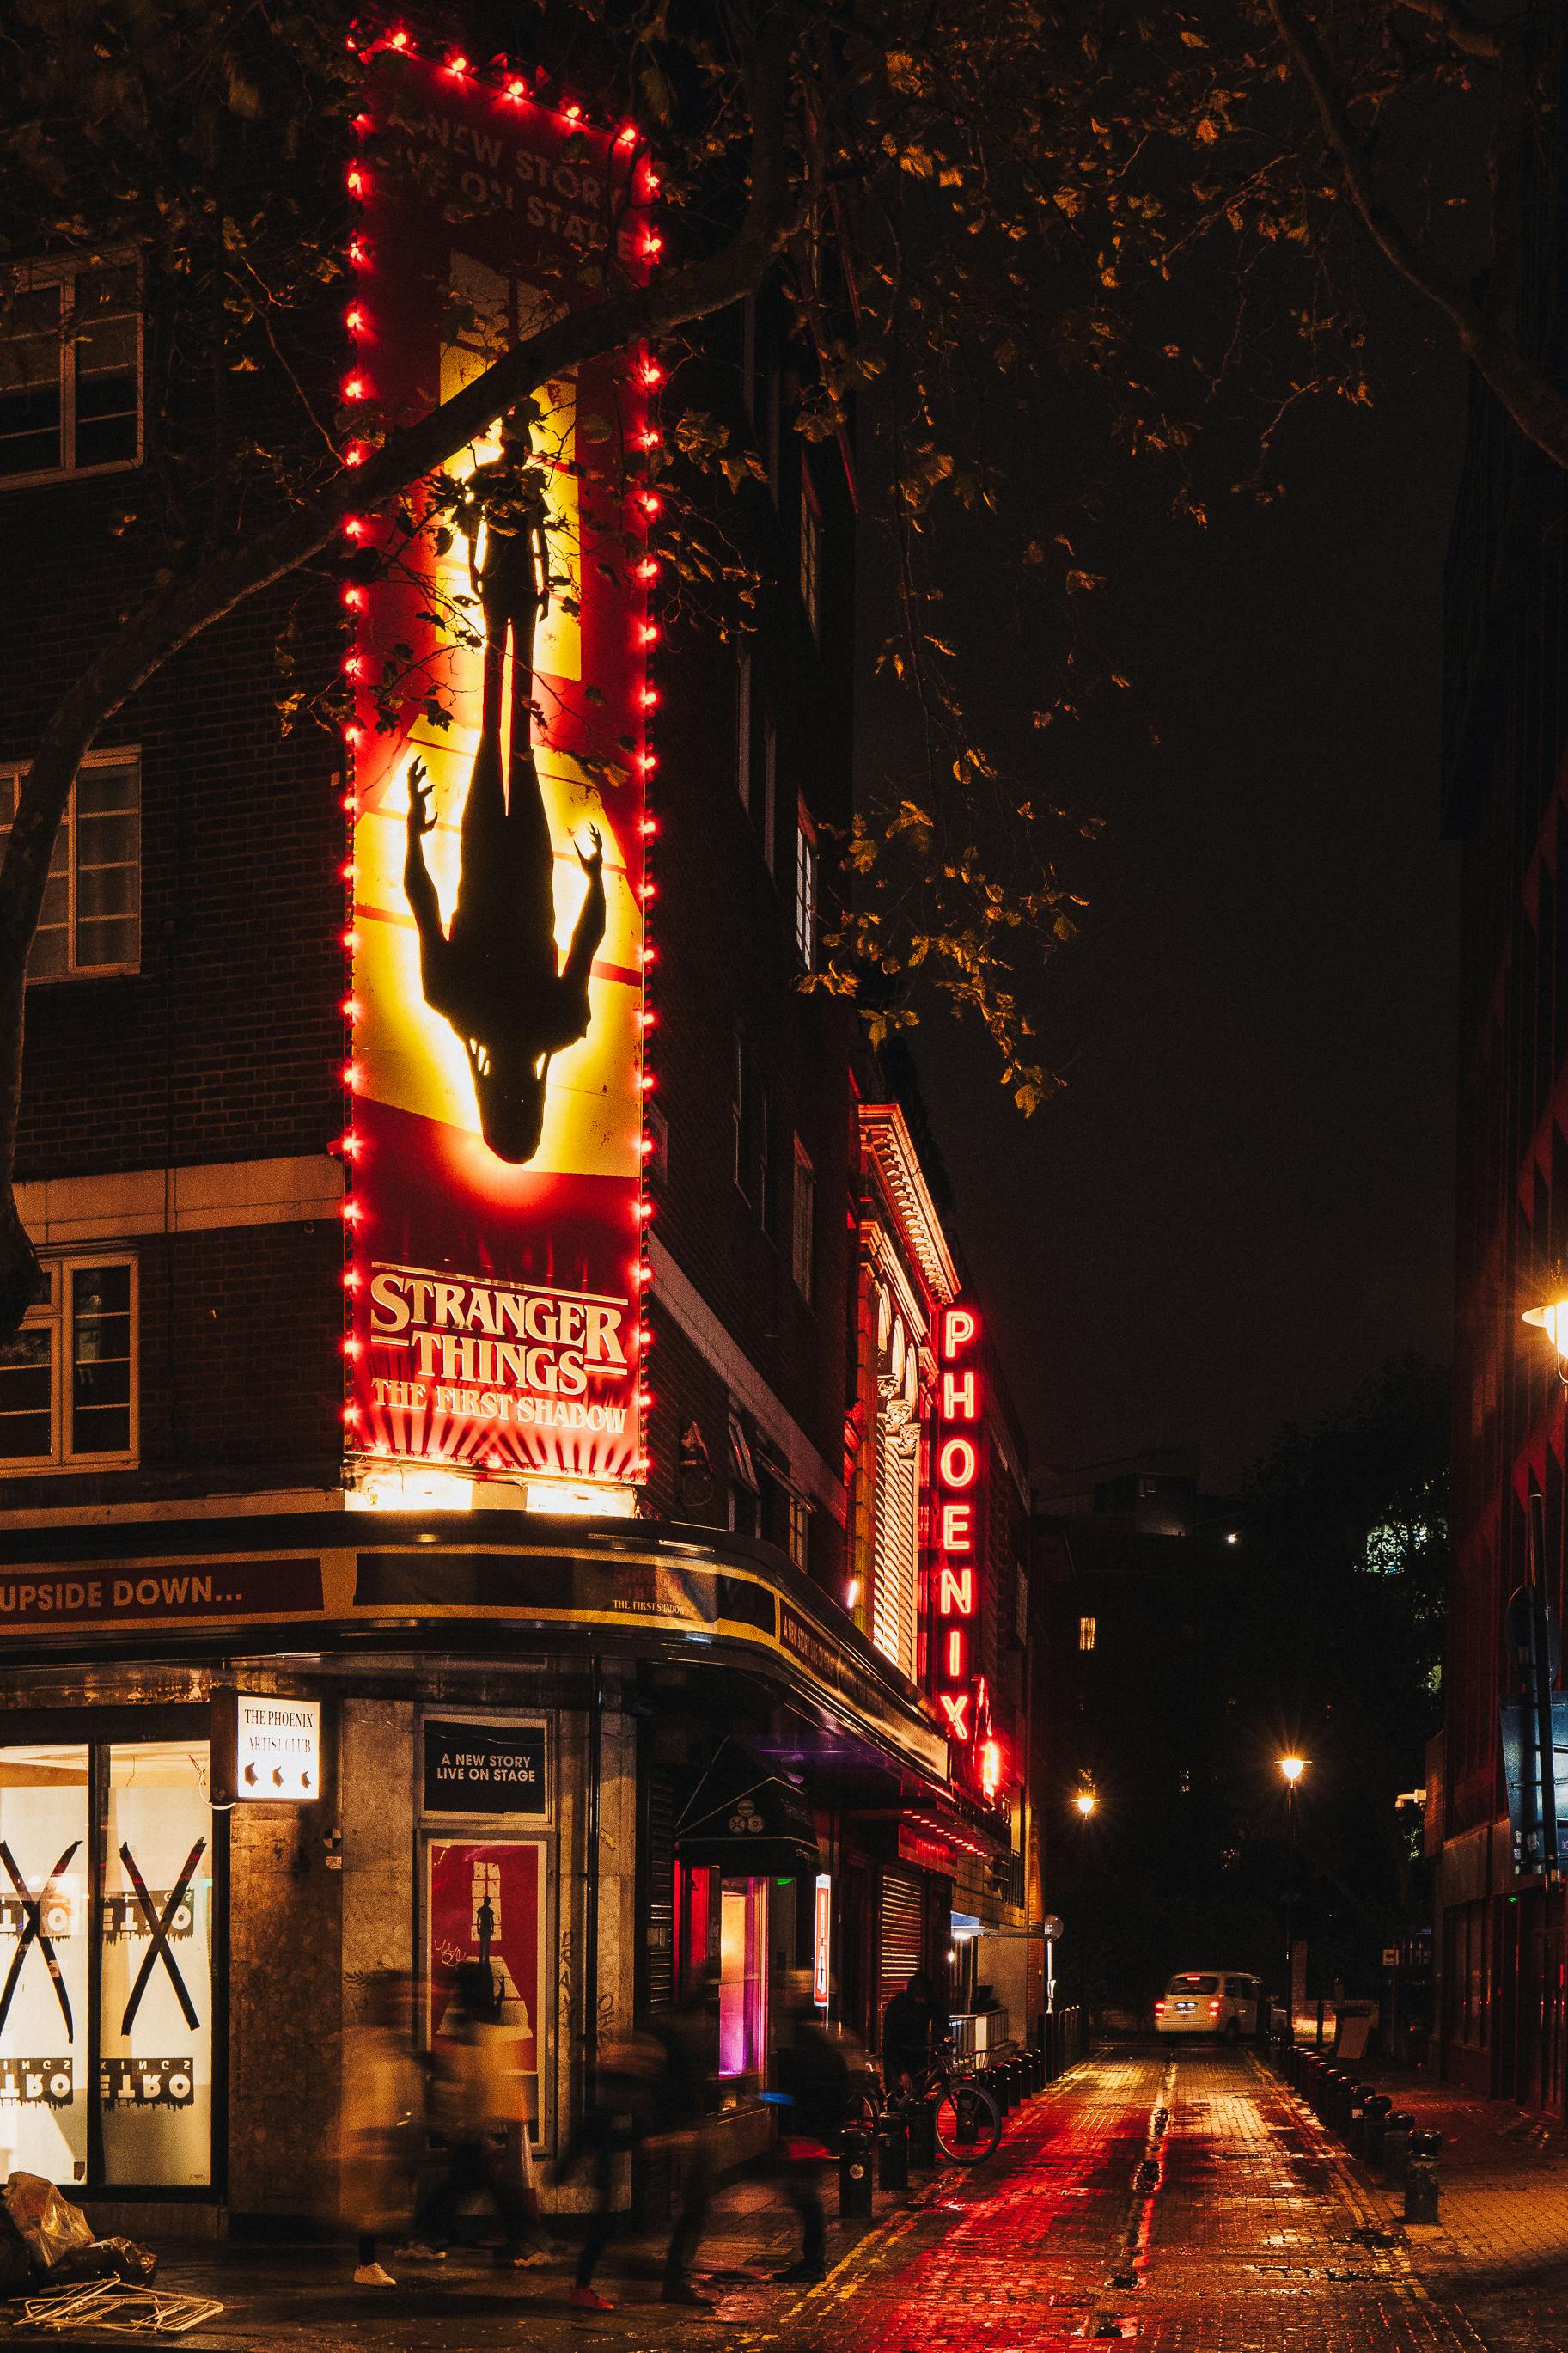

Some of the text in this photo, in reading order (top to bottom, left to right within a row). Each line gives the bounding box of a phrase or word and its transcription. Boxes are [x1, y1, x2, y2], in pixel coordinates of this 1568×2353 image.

[371, 1274, 627, 1364] STRANGER
[412, 1330, 588, 1396] THINGS
[371, 1378, 627, 1434] THE FIRST SHADOW
[940, 1311, 976, 1741] PHOENIX
[0, 1576, 243, 1611] UPSIDE DOWN...
[613, 1599, 631, 1610] THE
[633, 1601, 656, 1611] FIRST
[244, 1708, 314, 1727] THE PHOENIX
[436, 1767, 535, 1782] LIVE ON STAGE
[441, 1753, 531, 1769] A NEW STORY
